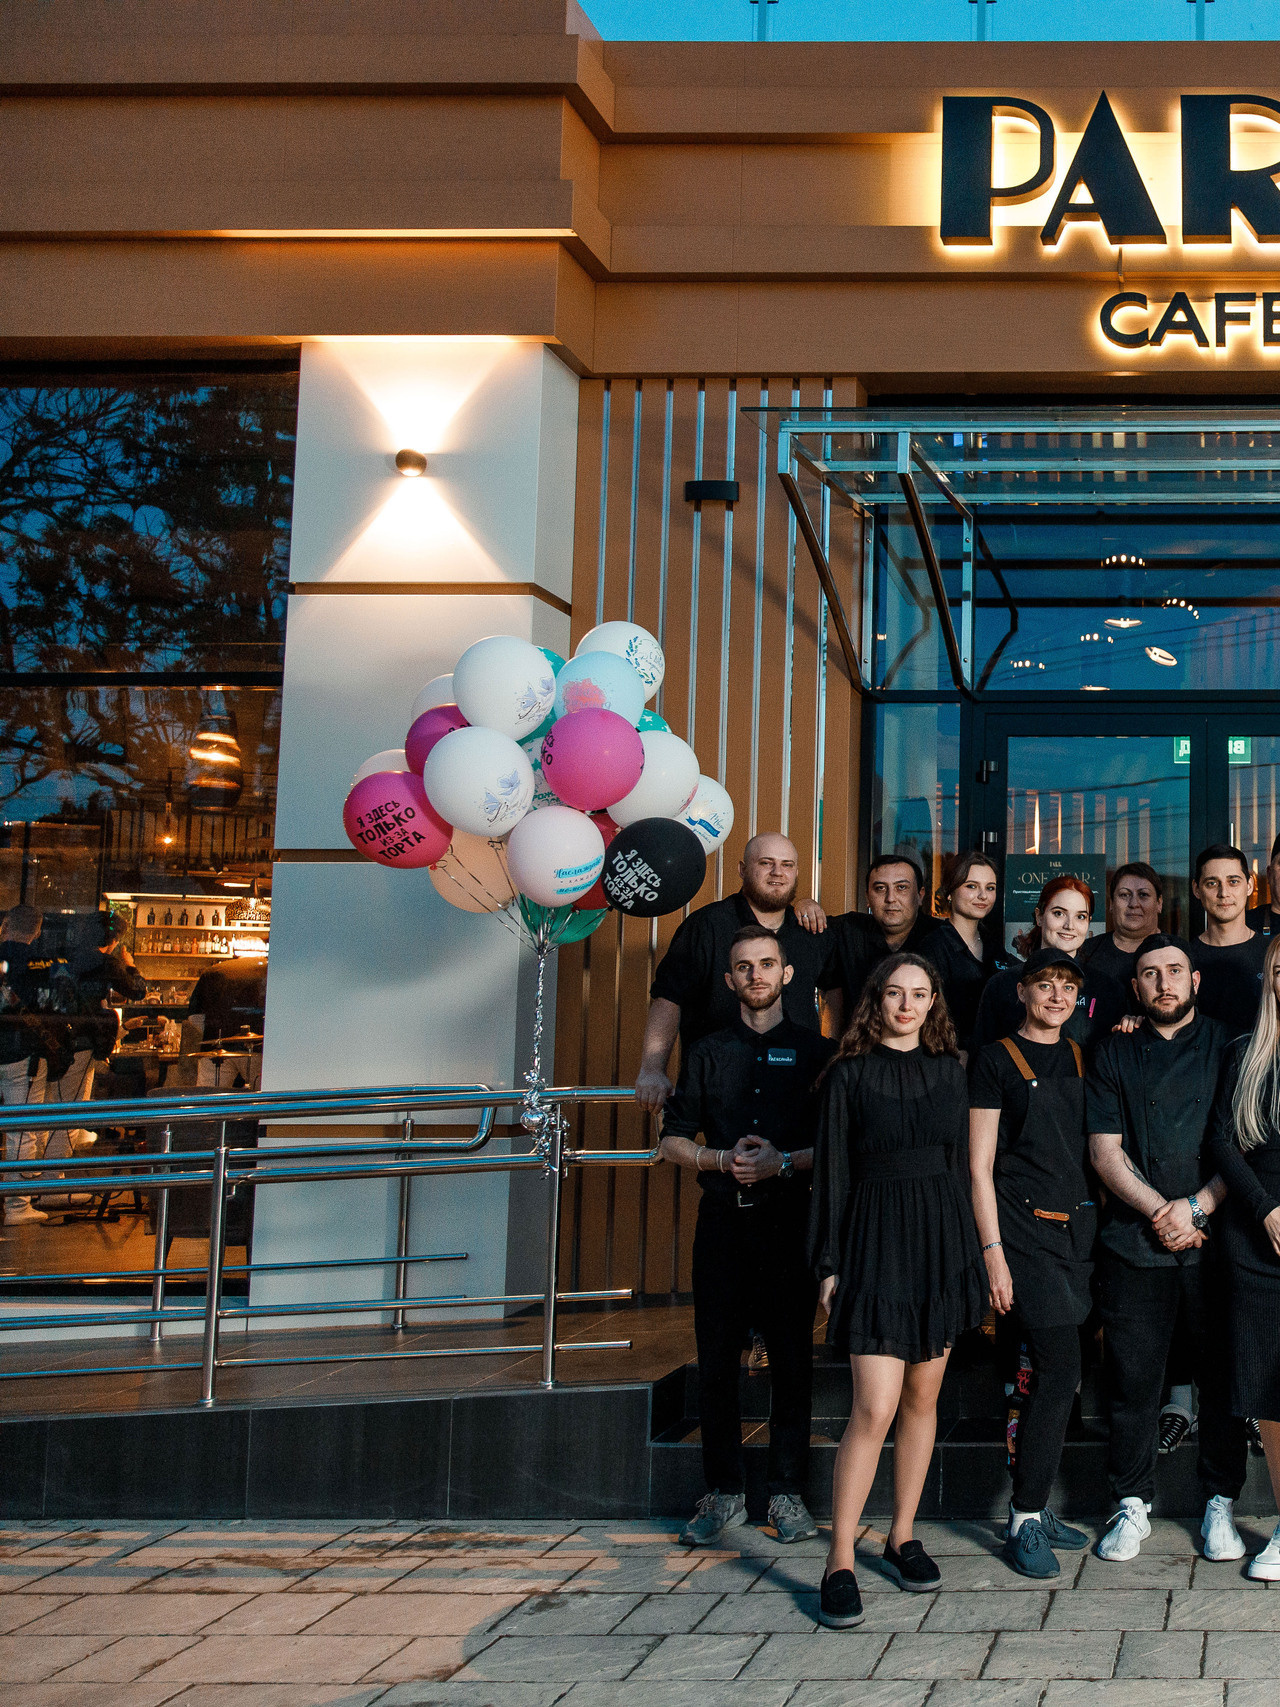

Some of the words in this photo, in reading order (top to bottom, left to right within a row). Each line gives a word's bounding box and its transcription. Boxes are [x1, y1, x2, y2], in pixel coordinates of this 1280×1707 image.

[357, 817, 365, 828] Я
[365, 801, 400, 823] ЗДЕСЬ
[357, 807, 415, 844] ТОЛЬКО
[379, 831, 426, 860] ТОРТА
[380, 828, 409, 847] ИЗ-ЗА
[612, 851, 659, 901] ТОЛЬКО
[625, 849, 638, 861] Я
[632, 858, 661, 887] ЗДЕСЬ
[604, 872, 634, 909] ТОРТА
[614, 875, 635, 899] ИЗ-ЗА
